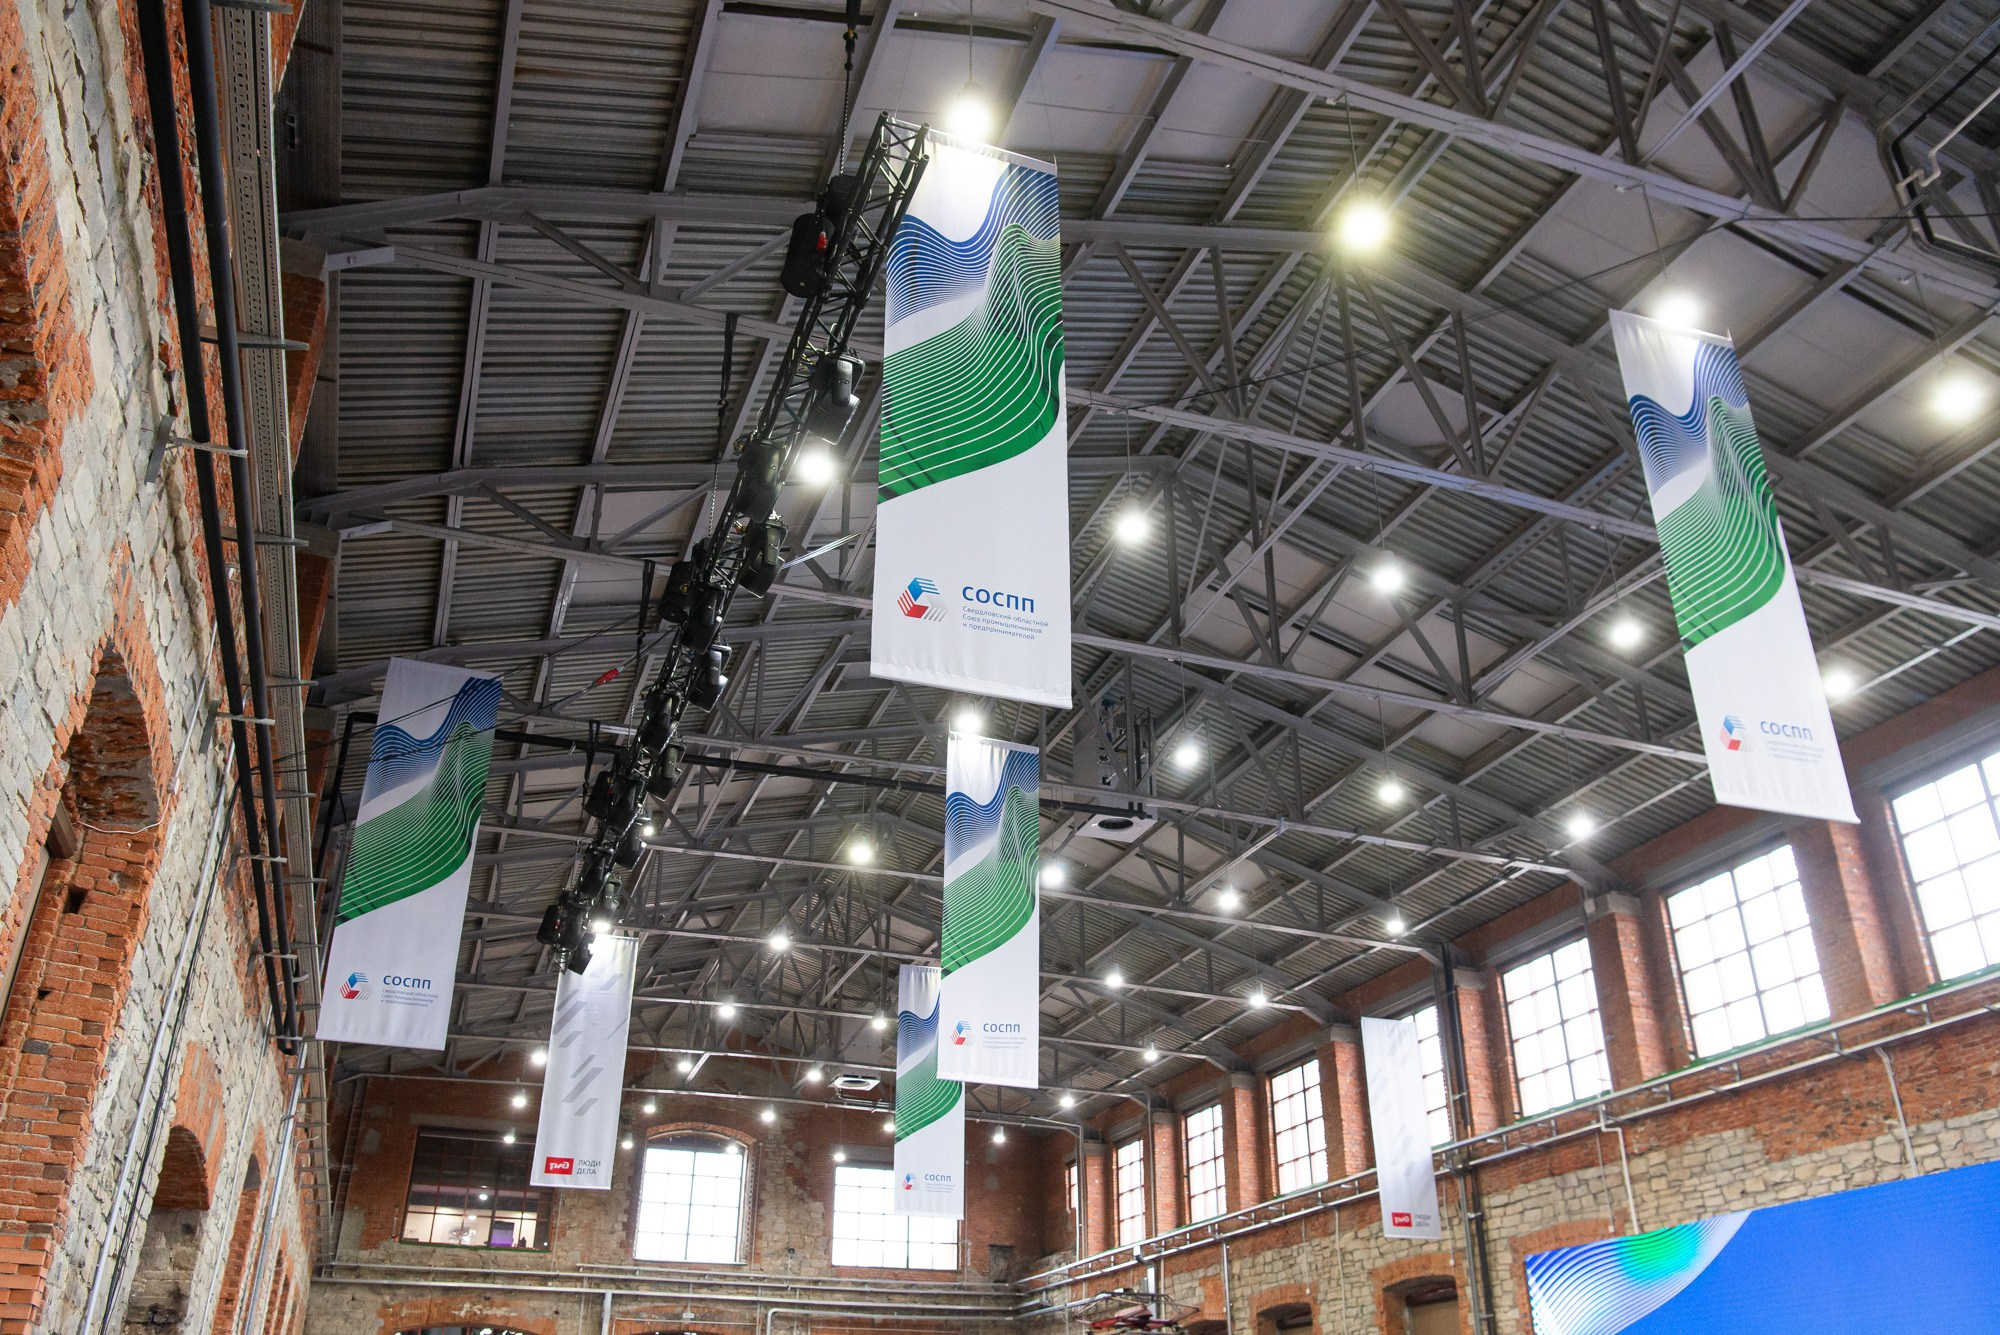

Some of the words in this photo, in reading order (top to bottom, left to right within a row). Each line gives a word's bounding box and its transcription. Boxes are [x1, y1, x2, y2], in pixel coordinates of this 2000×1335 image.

[962, 586, 1034, 613] СОСПП
[962, 605, 1012, 620] Свердловский
[1013, 616, 1049, 628] областной
[962, 613, 981, 623] Союз
[982, 618, 1042, 634] промышленников
[969, 623, 1035, 640] предпринимателей
[1760, 721, 1813, 741] СОСПП
[383, 975, 431, 989] СОСПП
[983, 1023, 1021, 1033] СОСПП
[577, 1159, 601, 1168] ЛЮДИ
[924, 1173, 952, 1182] СОСПП
